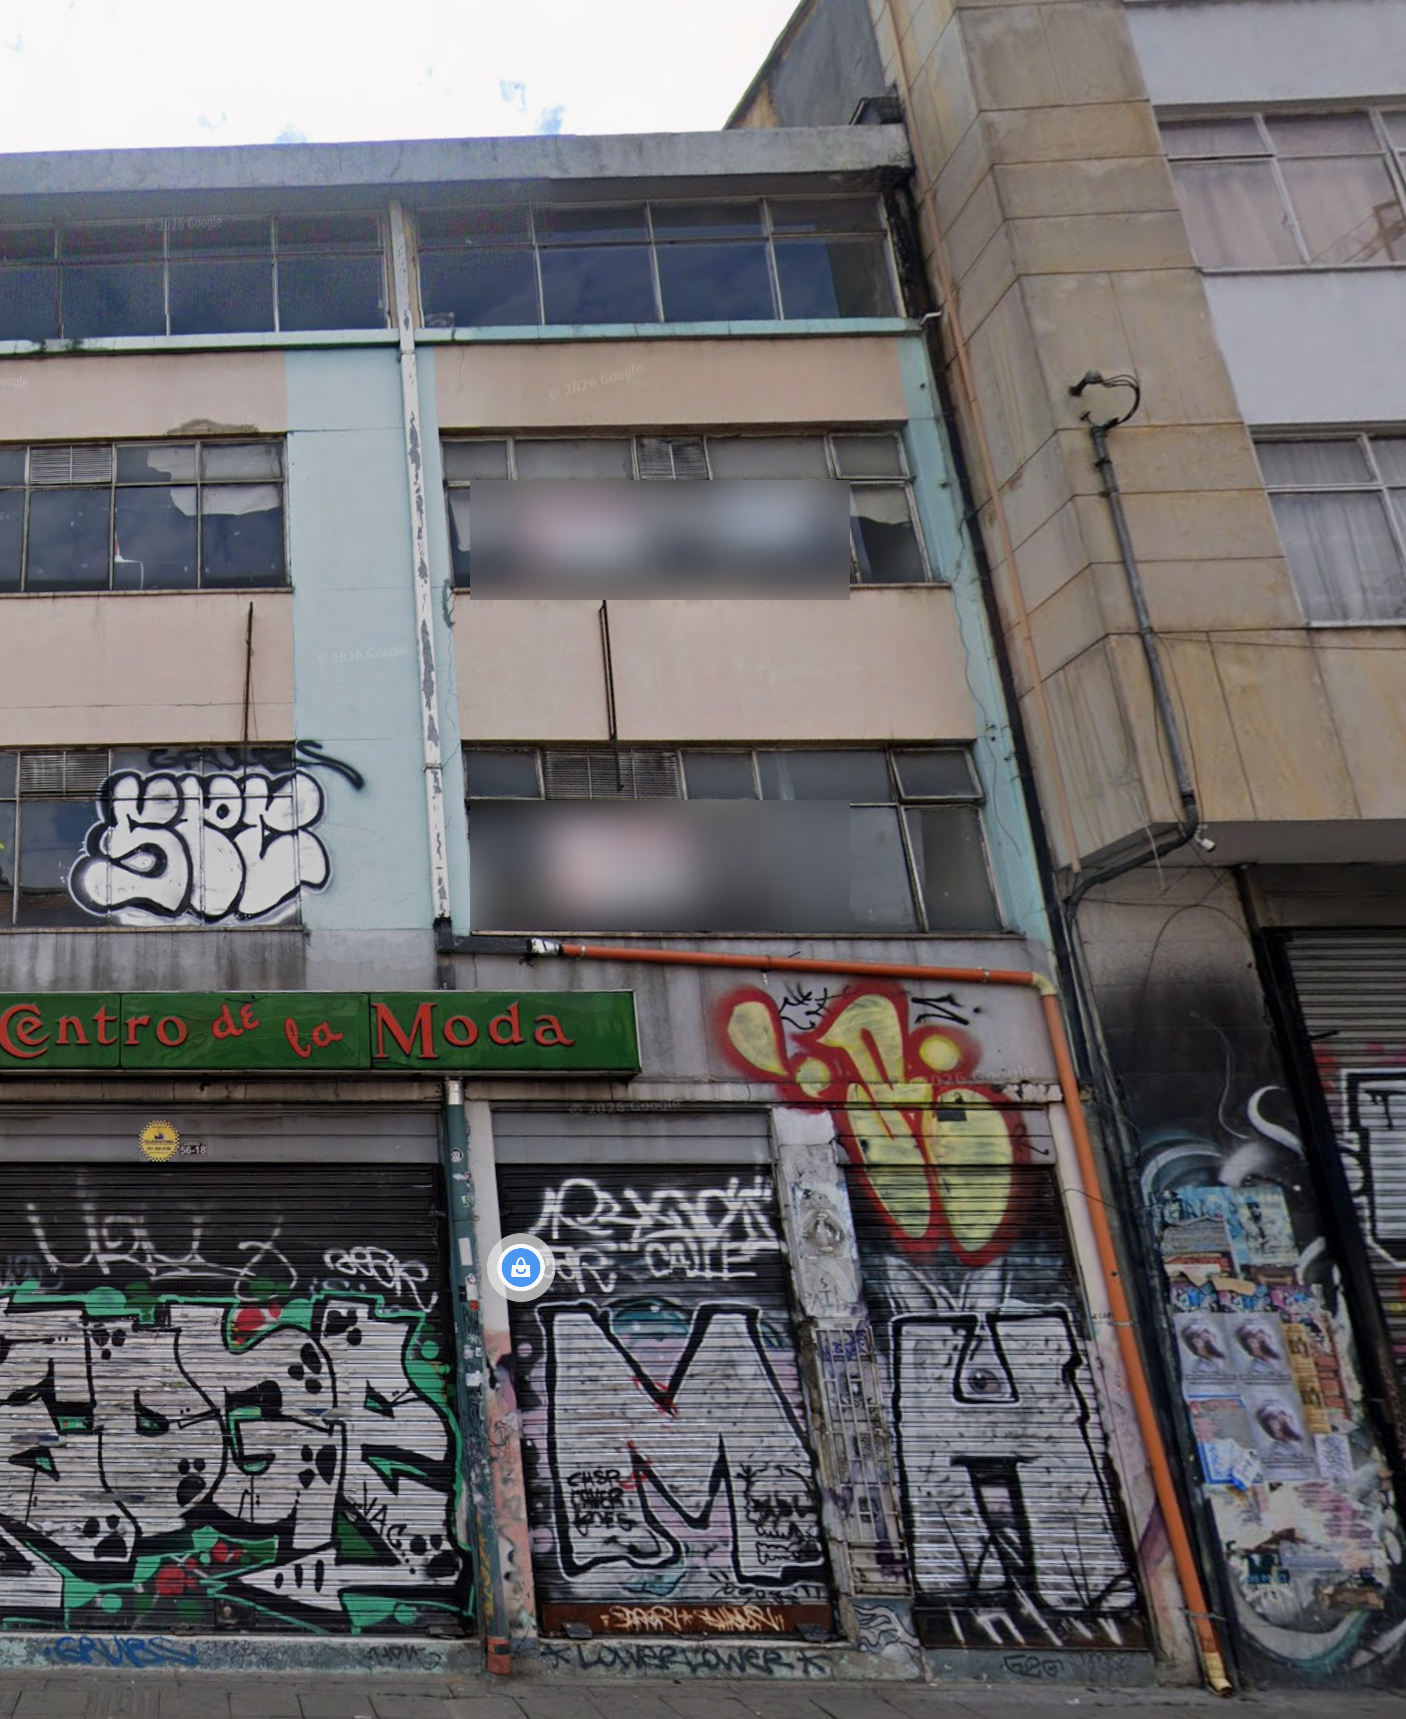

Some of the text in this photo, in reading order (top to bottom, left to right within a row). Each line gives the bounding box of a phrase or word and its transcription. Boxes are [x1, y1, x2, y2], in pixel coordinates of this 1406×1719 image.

[0, 1003, 189, 1059] Centro
[285, 1017, 344, 1059] la
[371, 1001, 576, 1060] Moda
[180, 1145, 207, 1155] 56-18
